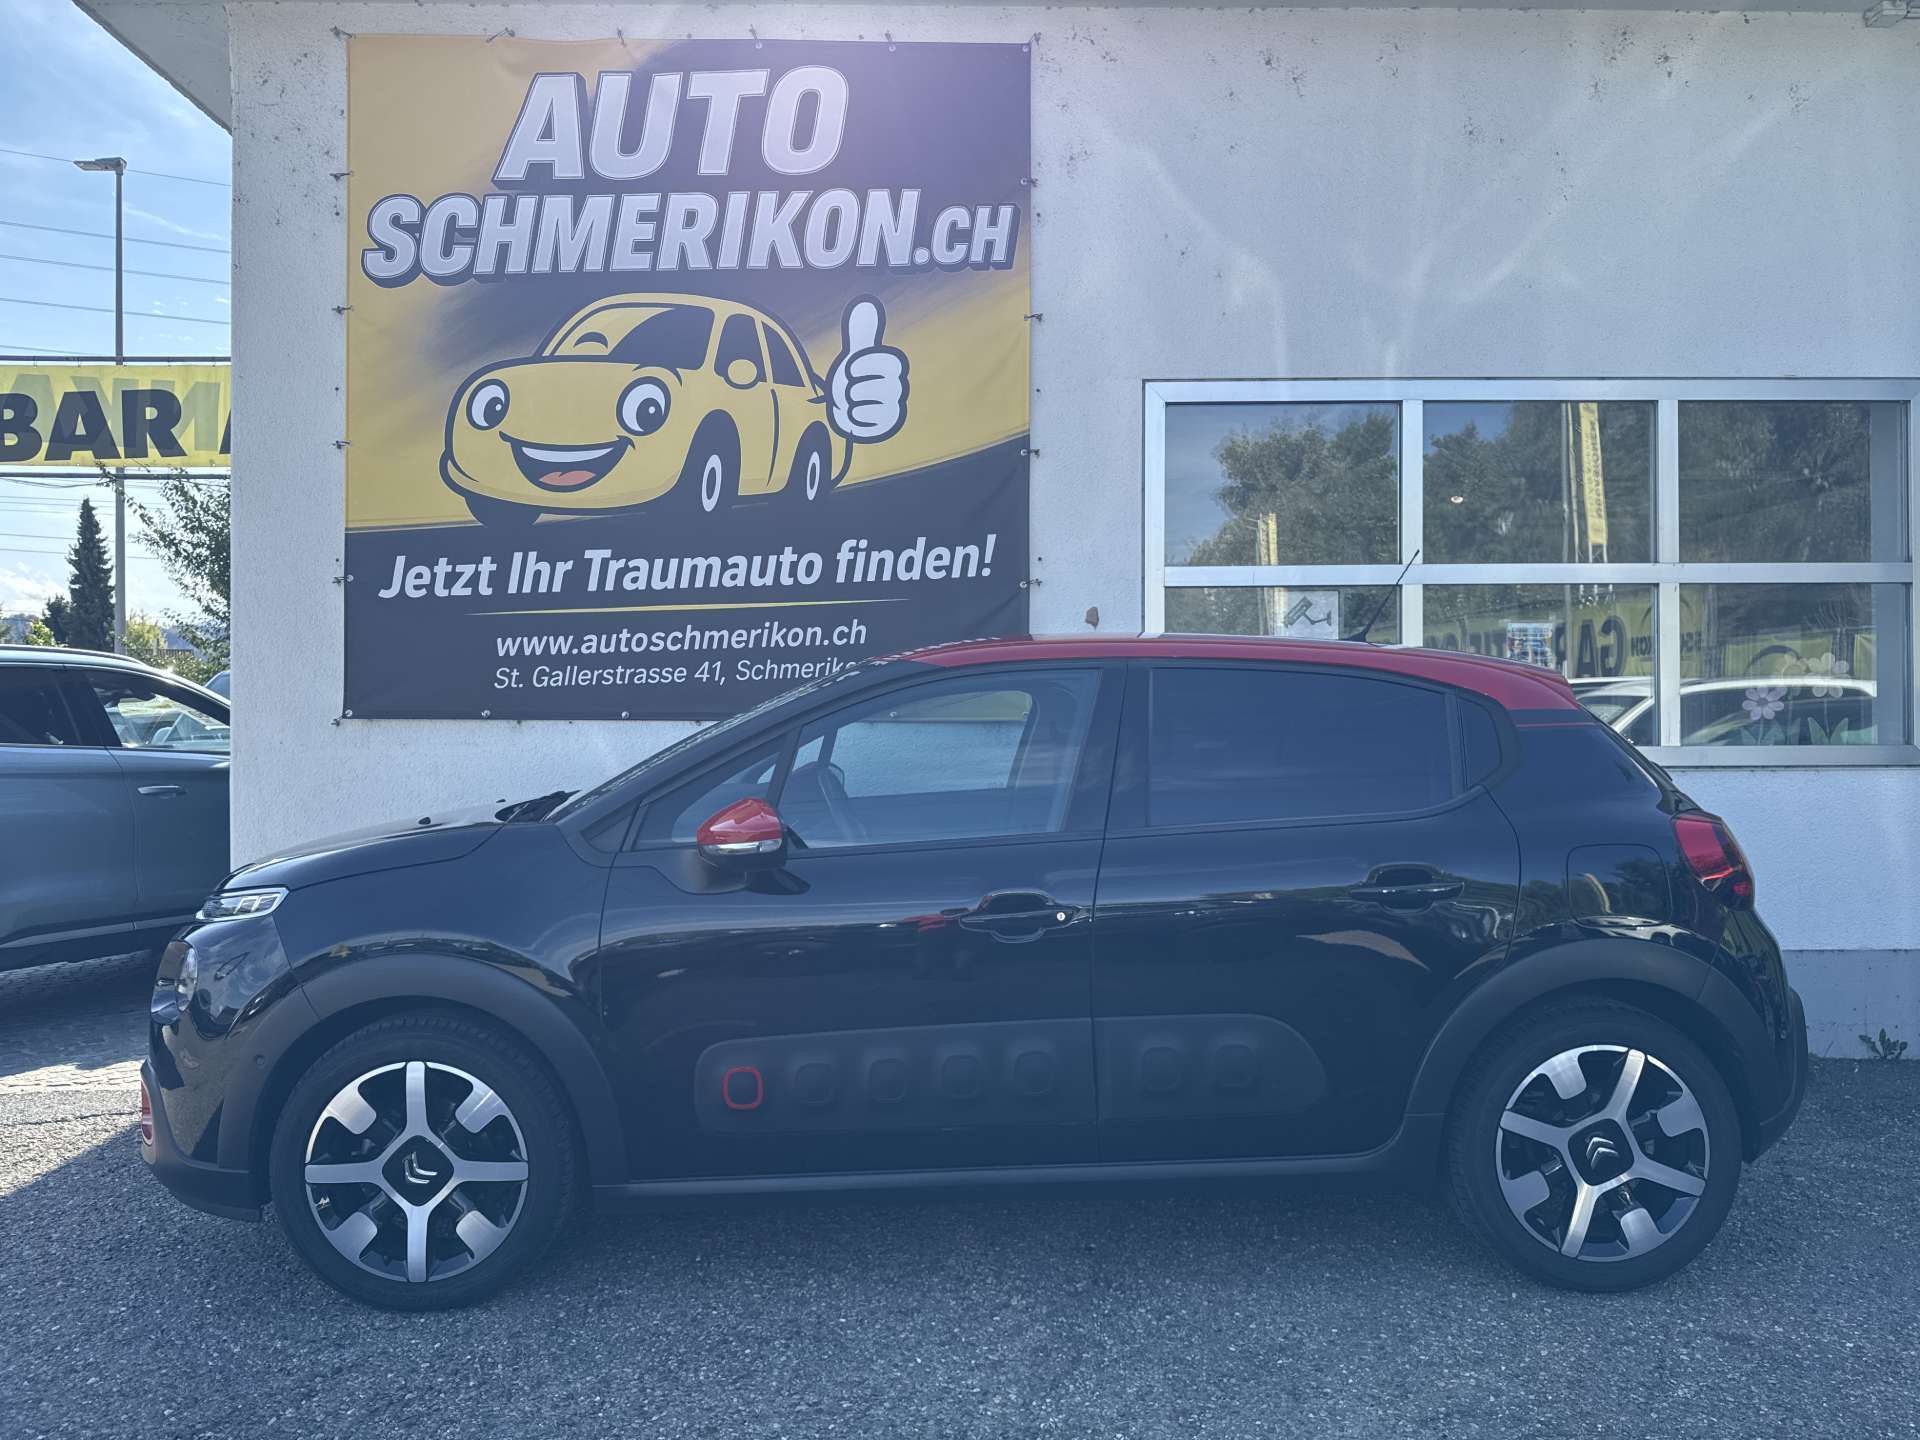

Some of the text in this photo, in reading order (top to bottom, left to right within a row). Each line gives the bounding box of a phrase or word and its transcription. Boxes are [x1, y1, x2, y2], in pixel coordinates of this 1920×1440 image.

[494, 64, 850, 184] AUTO
[362, 187, 1018, 279] SCHMERIKON.CH
[0, 388, 188, 463] BAR
[377, 533, 997, 599] Jetzt Ihr Traumauto finden!
[496, 618, 867, 657] www.autoschmerikon.ch
[494, 667, 524, 689] St.
[532, 664, 687, 688] Gallerstrasse
[694, 660, 726, 686] 41,
